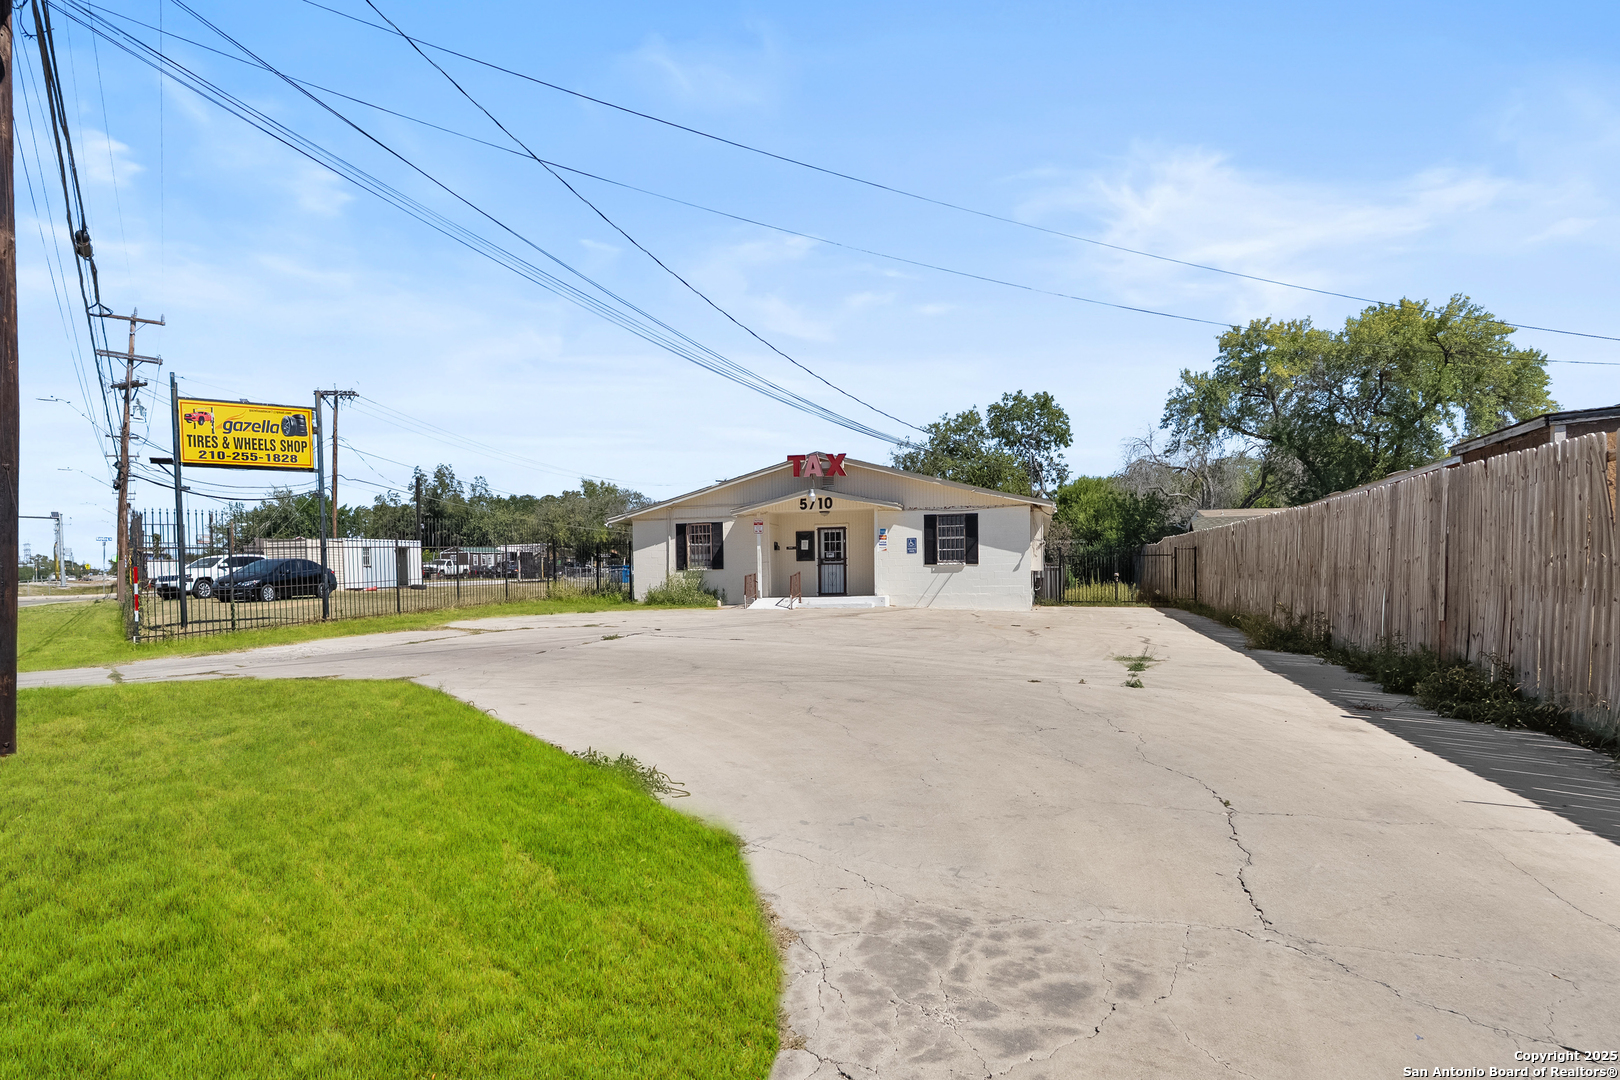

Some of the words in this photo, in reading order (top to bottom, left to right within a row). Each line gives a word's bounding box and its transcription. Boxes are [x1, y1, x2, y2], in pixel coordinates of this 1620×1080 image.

[223, 419, 280, 434] gazella
[187, 434, 218, 449] TIRES
[222, 436, 230, 449] &
[233, 436, 276, 452] WHEELS
[280, 439, 307, 453] SHOP
[198, 449, 298, 463] 210-255-1828
[787, 453, 848, 477] TAX
